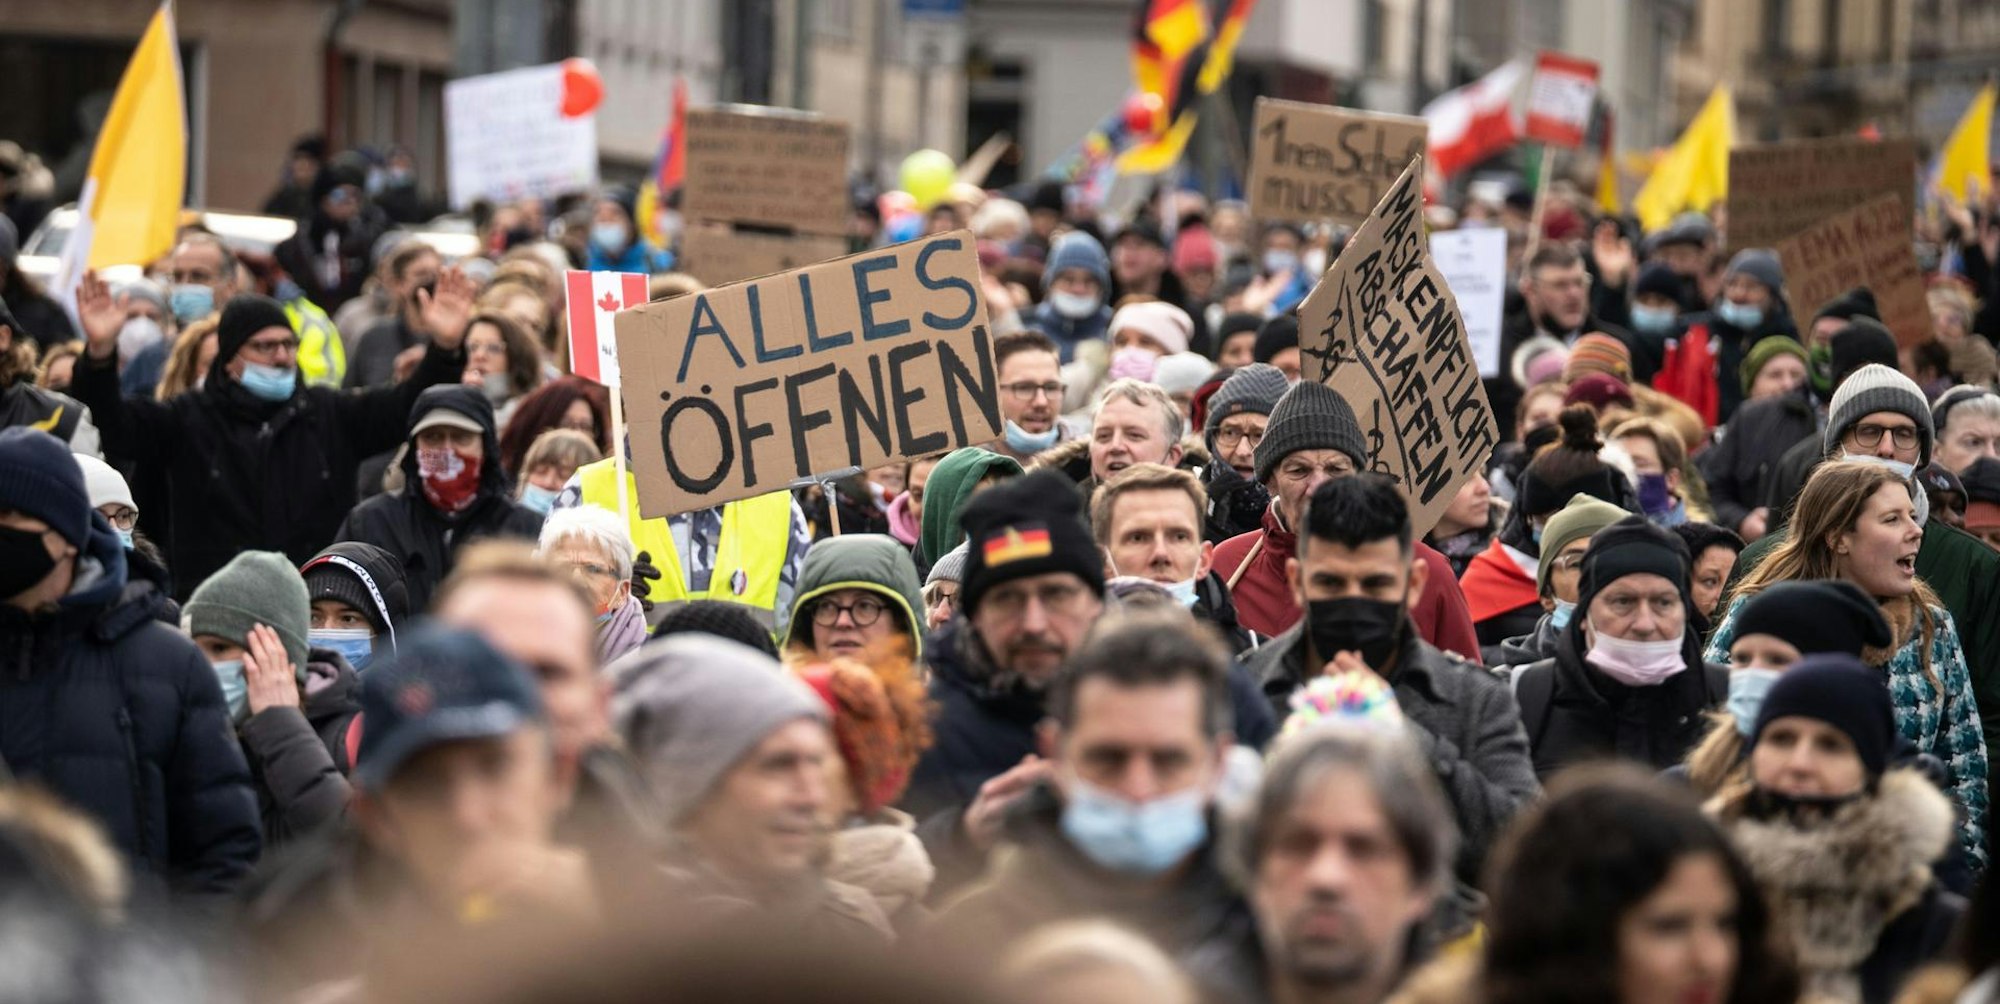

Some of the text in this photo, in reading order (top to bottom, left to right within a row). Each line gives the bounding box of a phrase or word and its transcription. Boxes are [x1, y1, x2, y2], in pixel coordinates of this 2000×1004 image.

[660, 325, 1002, 494] ÖFFNEN
[676, 238, 977, 383] ALLES
[1355, 250, 1452, 505] ABSCHAFFEN
[1380, 174, 1493, 475] MASKENPFLICHT
